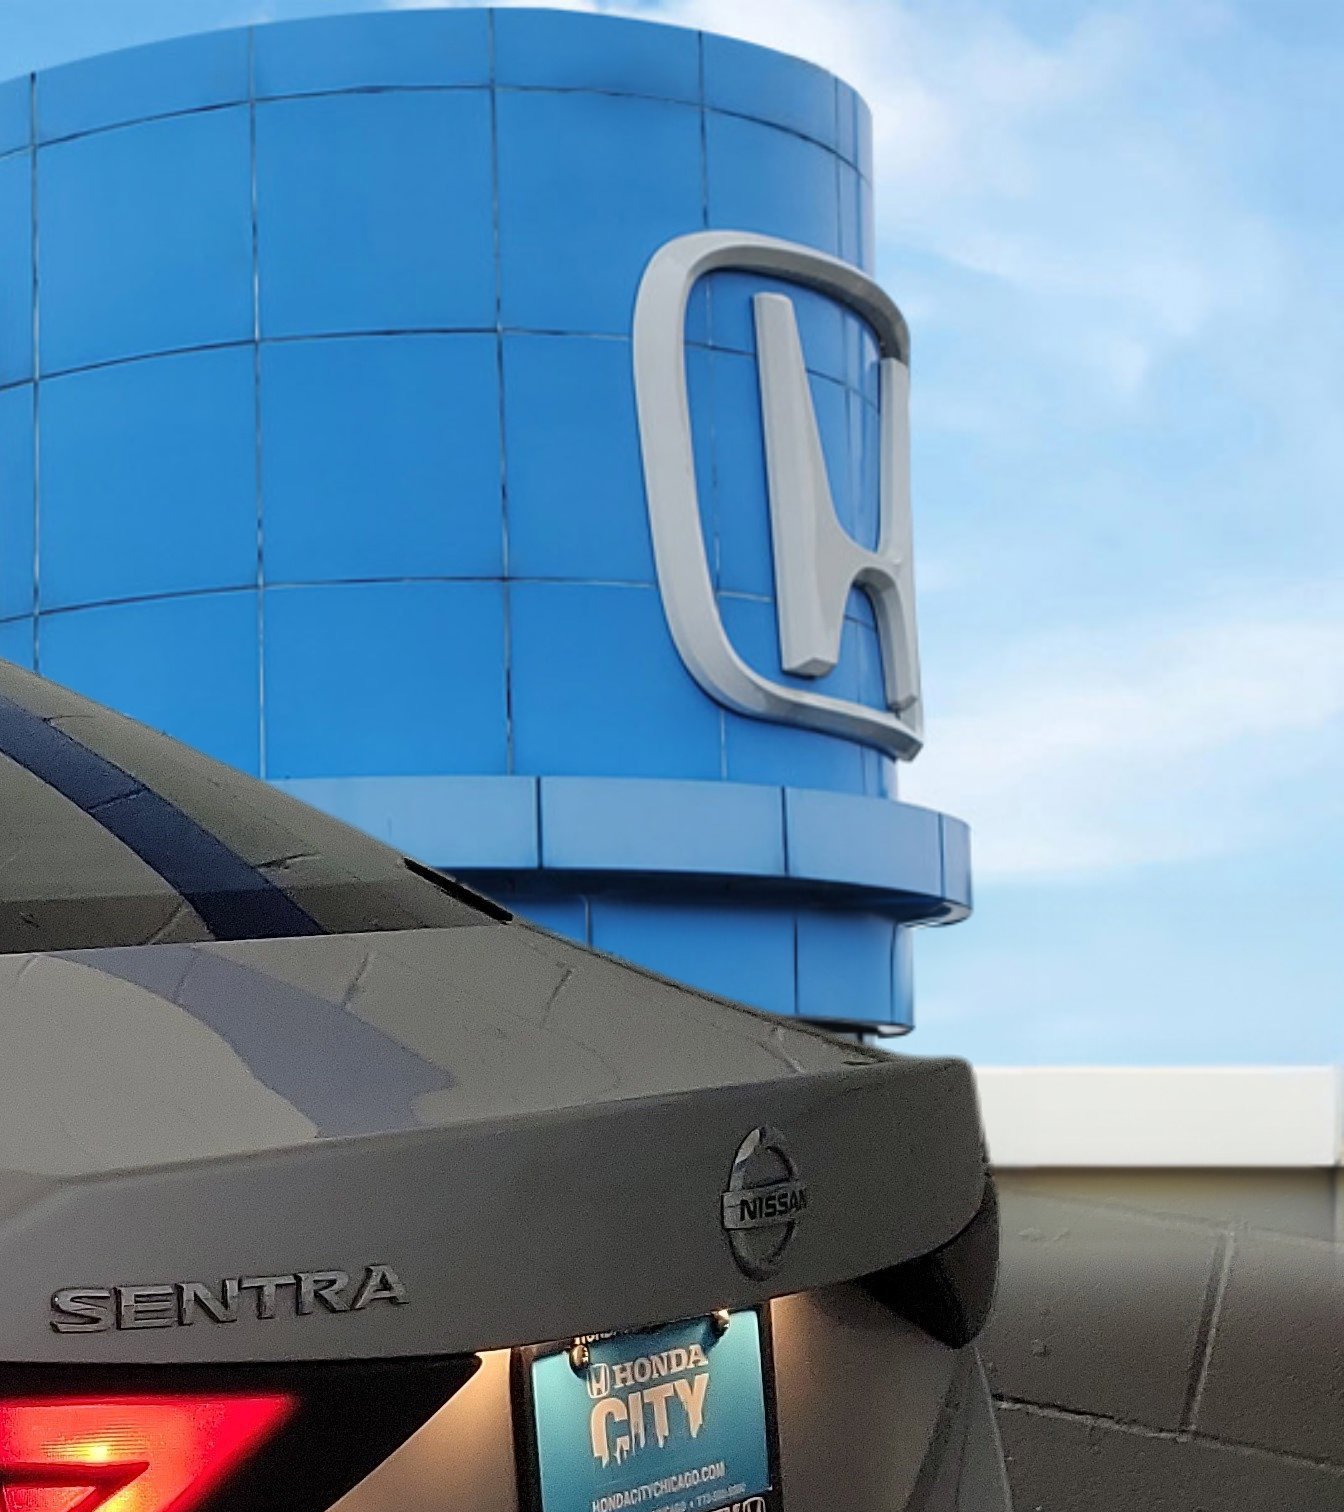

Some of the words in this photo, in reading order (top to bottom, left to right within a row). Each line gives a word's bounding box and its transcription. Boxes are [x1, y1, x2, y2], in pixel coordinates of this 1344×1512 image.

[739, 1187, 807, 1222] NISSAN
[50, 1263, 410, 1334] SENTRA
[612, 1343, 709, 1389] HONDA
[591, 1372, 710, 1469] CITY
